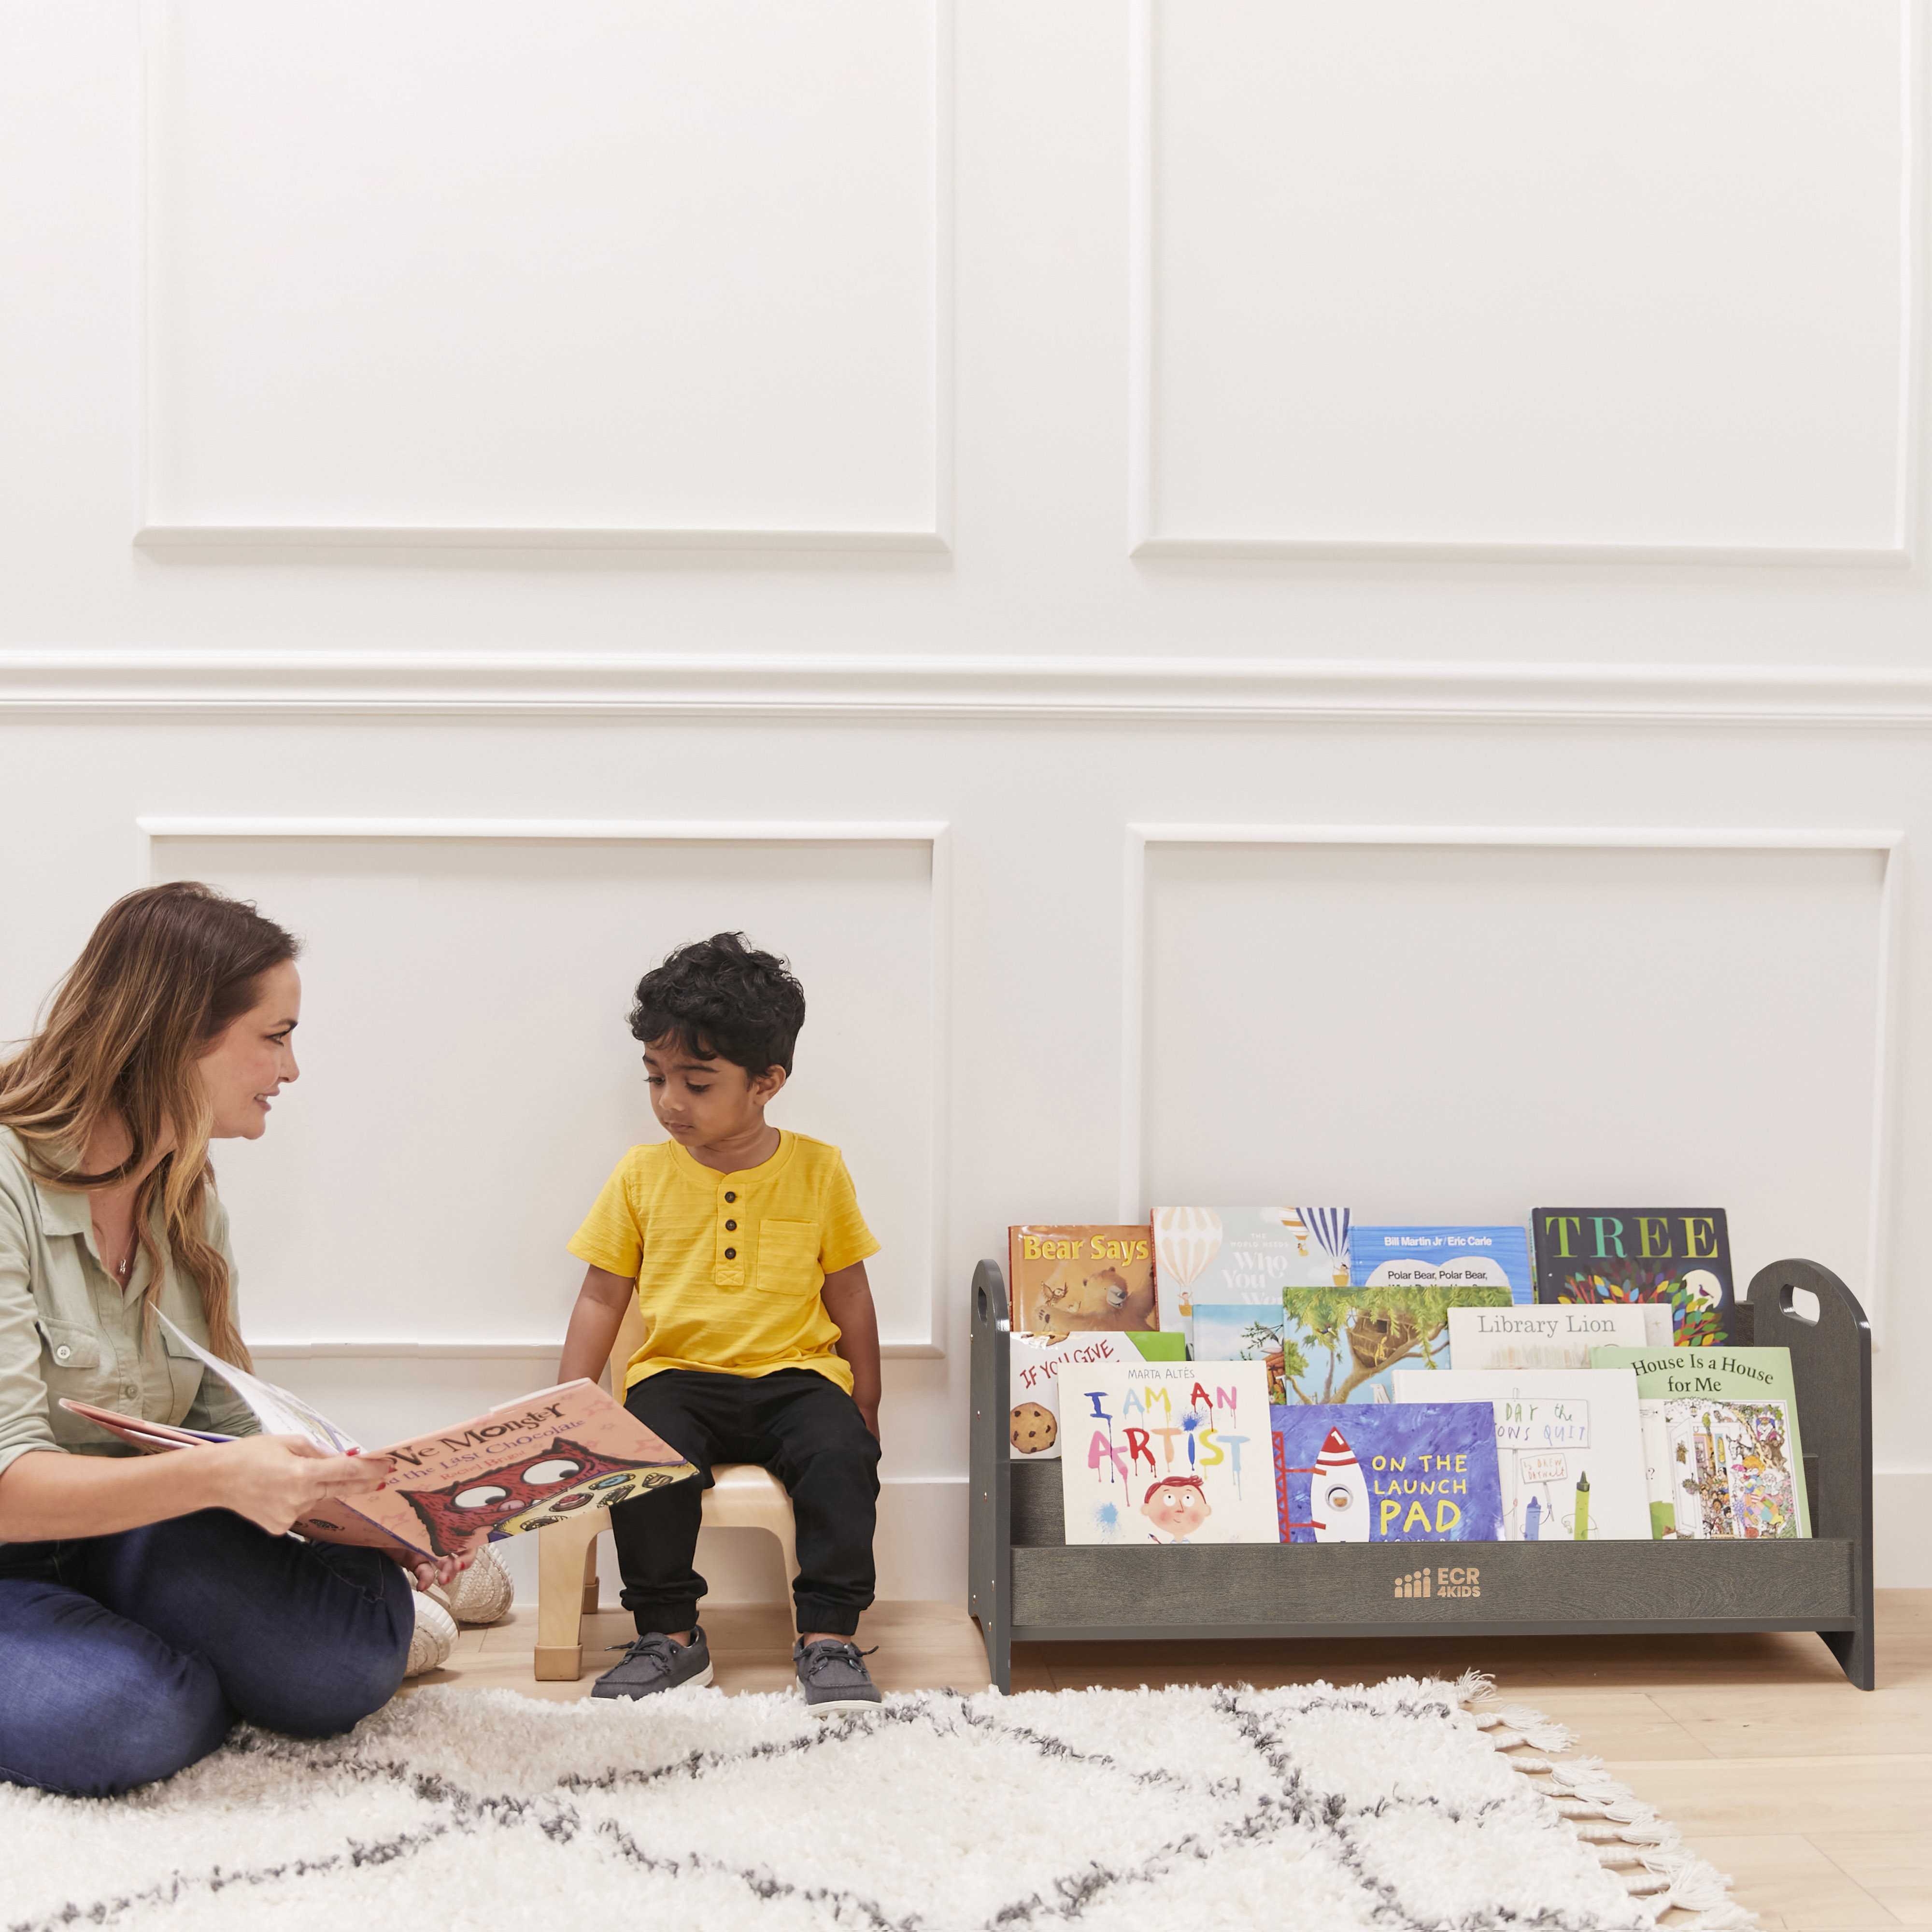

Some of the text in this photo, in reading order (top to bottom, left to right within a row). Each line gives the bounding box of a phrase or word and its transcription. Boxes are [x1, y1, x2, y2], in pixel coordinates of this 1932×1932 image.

[1384, 1236, 1399, 1246] Bill
[1401, 1236, 1431, 1246] Martin
[1433, 1237, 1442, 1246] Jr
[1448, 1236, 1466, 1246] Eric
[1467, 1236, 1492, 1246] Carle
[1546, 1217, 1718, 1258] TREE
[1023, 1235, 1083, 1260] Bear
[1090, 1234, 1149, 1267] Says
[1233, 1251, 1288, 1279] Who
[1222, 1269, 1266, 1289] You
[1388, 1271, 1488, 1280] Polar Bear, Polar Bear,
[1477, 1315, 1616, 1338] Library Lion
[1020, 1365, 1037, 1389] IF
[1074, 1339, 1114, 1363] GIVE
[1128, 1367, 1194, 1379] MARTA ALTÉS
[1631, 1354, 1774, 1385] House Is a House
[1668, 1376, 1722, 1392] for Me
[1122, 1386, 1172, 1418] AM
[1190, 1382, 1237, 1413] AN
[1506, 1402, 1573, 1422] DAY the
[437, 1403, 565, 1452] Monster
[1544, 1424, 1586, 1447] QUIT
[1331, 1431, 1345, 1446] 1
[1088, 1427, 1251, 1478] ARTIST
[403, 1467, 435, 1479] the
[1372, 1454, 1467, 1473] ON THE
[1374, 1478, 1466, 1495] LAUNCH
[1380, 1499, 1461, 1535] PAD
[1438, 1567, 1480, 1585] ECR
[1437, 1586, 1481, 1597] 4KIDS
